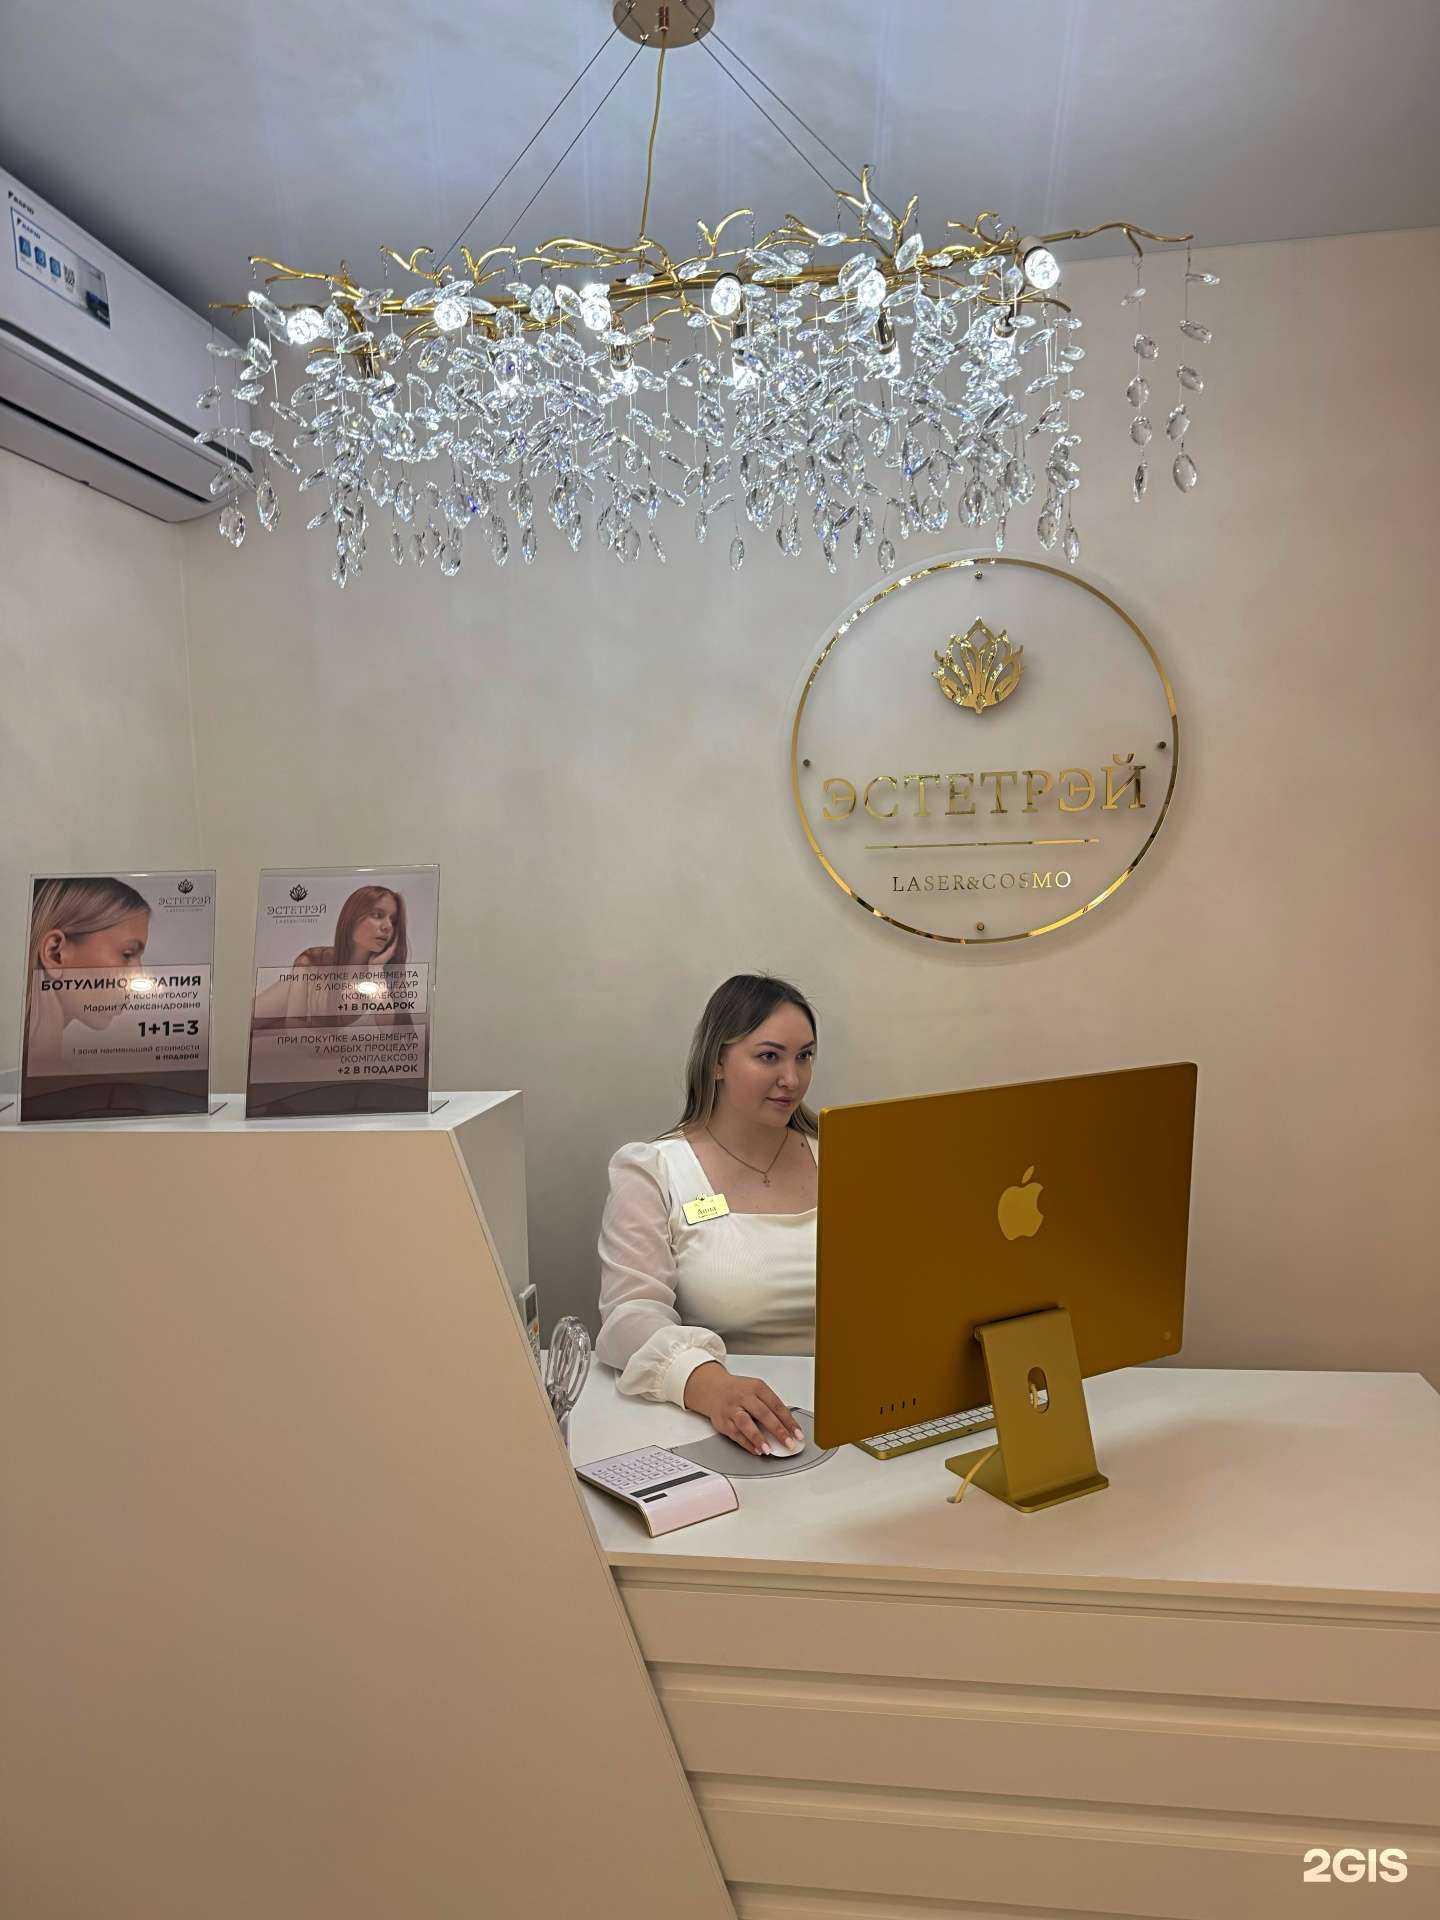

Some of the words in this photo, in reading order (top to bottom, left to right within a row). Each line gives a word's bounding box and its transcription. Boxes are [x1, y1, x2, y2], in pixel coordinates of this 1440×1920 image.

[822, 753, 1146, 820] ЭСТЕТРЭЙ
[892, 871, 1072, 892] LASER&COSMO
[279, 973, 299, 982] ПРИ
[302, 972, 349, 982] ПОКУПКЕ
[352, 970, 419, 981] АБОНЕМЕНТА
[41, 975, 201, 991] БОТУЛИНОРАПИЯ
[363, 980, 419, 990] ОЦЕДУР
[83, 1003, 117, 1012] Марии
[120, 1001, 201, 1011] Александровне
[337, 1003, 348, 1011] +1
[352, 1003, 359, 1011] В
[361, 1001, 415, 1011] ПОДАРОК
[138, 1019, 199, 1037] 1+1=3
[277, 1036, 298, 1045] ПРИ
[300, 1034, 348, 1044] ПОКУПКЕ
[351, 1032, 419, 1042] АБОНЕМЕНТА
[315, 1045, 321, 1053] 7
[323, 1045, 361, 1054] ЛЮБЫХ
[364, 1042, 419, 1052] ПРОЦЕДУР
[340, 1053, 418, 1064] (КОМПЛЕКСОВ)
[337, 1066, 350, 1075] +2
[353, 1065, 361, 1075] В
[363, 1064, 418, 1075] ПОДАРОК
